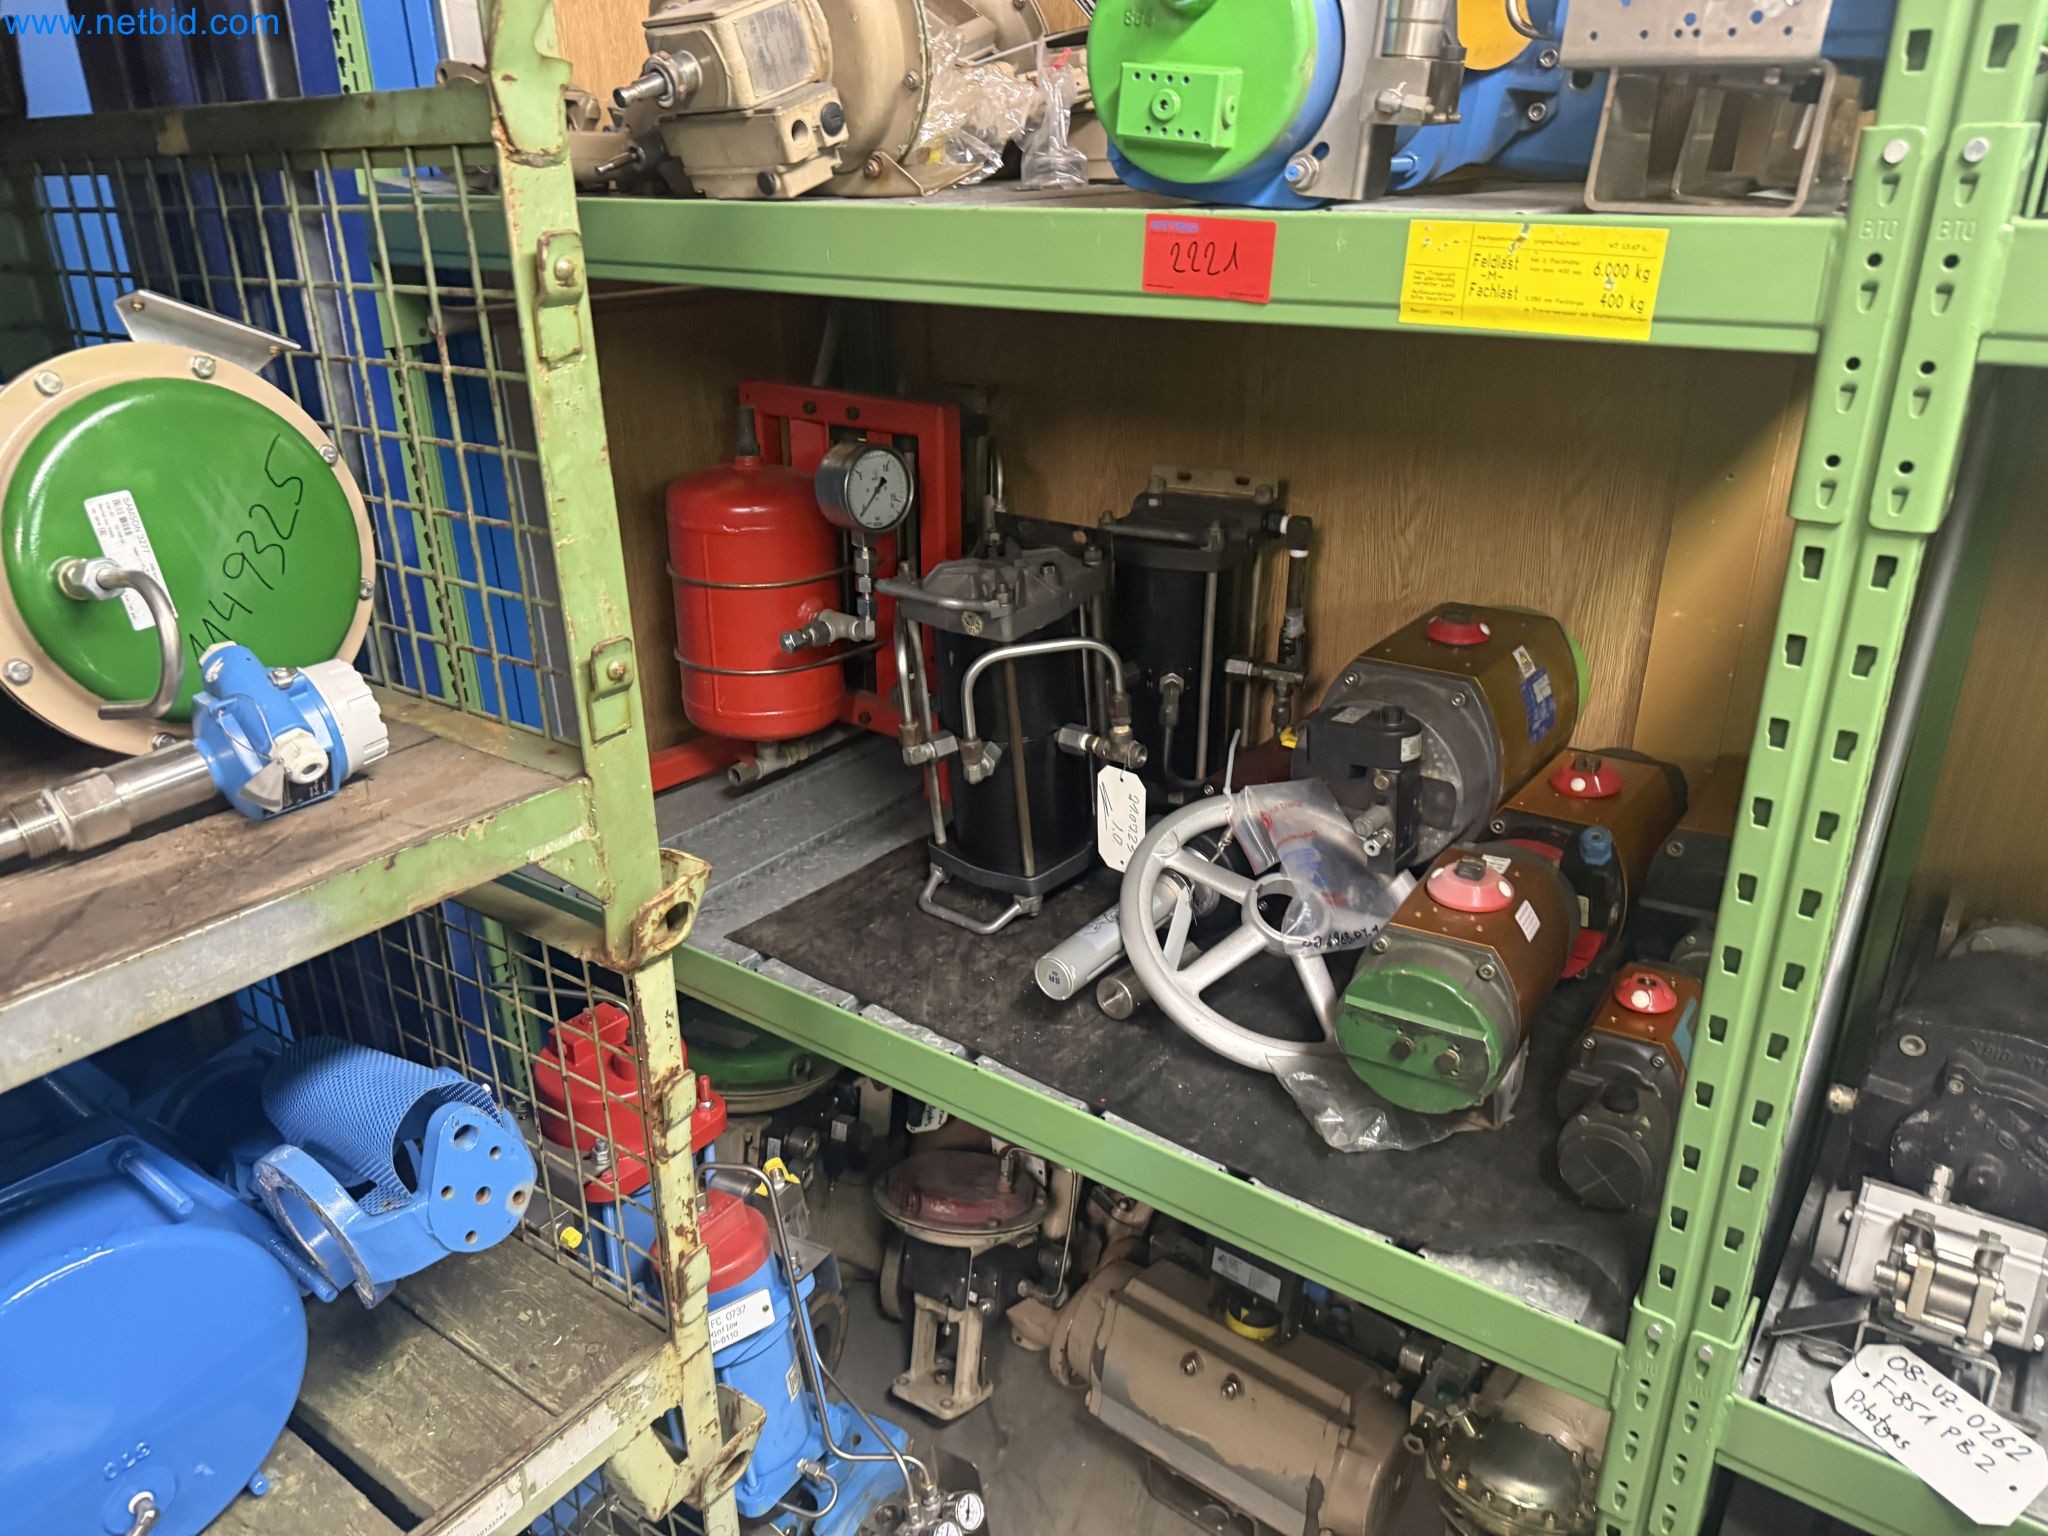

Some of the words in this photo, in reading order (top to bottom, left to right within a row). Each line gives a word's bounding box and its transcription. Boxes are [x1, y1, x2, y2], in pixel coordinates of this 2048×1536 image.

[1170, 241, 1238, 276] 2221
[1473, 253, 1519, 271] Feldlast
[1593, 261, 1630, 278] 6.000
[1635, 264, 1650, 283] kg
[1469, 282, 1519, 300] Fachlast
[1600, 293, 1624, 309] 400
[1630, 295, 1644, 314] kg
[122, 497, 141, 533] SAMSON
[137, 534, 150, 554] 3277
[710, 1317, 722, 1329] FC
[725, 1304, 746, 1321] 0737
[1873, 1374, 1938, 1425] F-851
